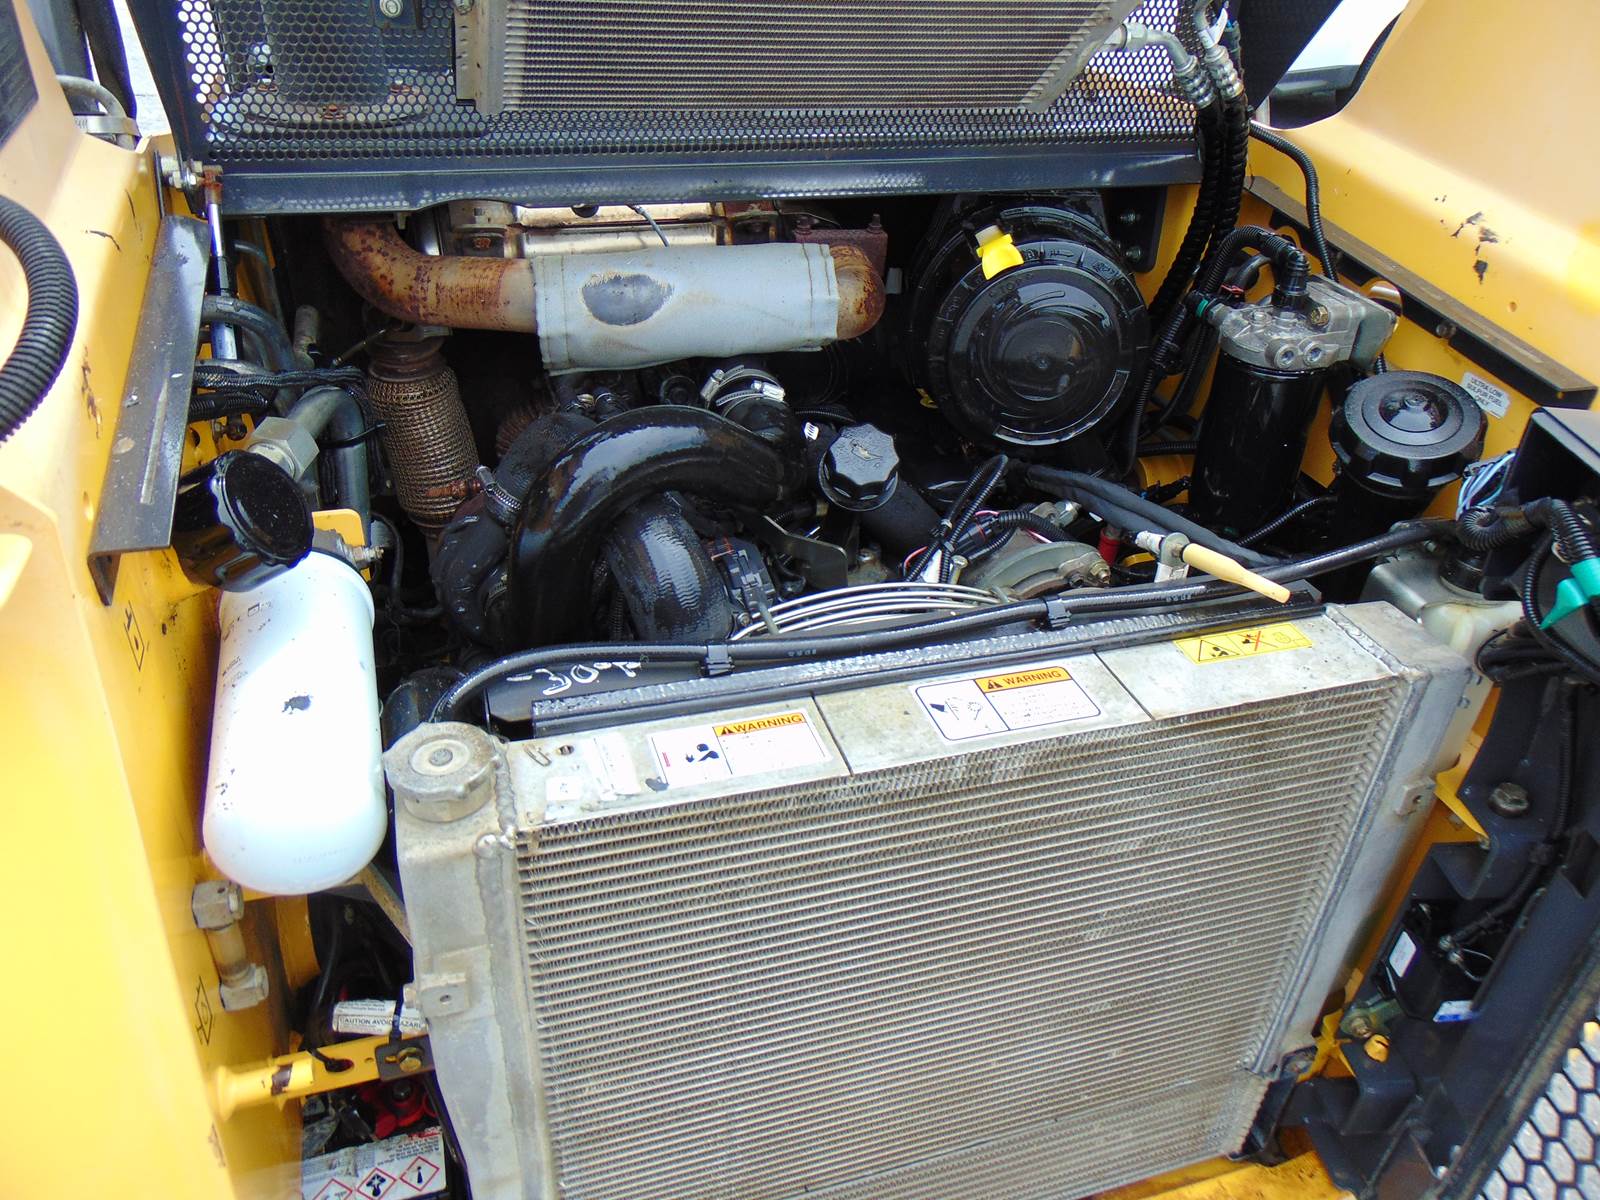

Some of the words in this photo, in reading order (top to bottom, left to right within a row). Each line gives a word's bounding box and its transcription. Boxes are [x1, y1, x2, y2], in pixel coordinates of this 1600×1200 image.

[1489, 387, 1503, 398] LOW
[1003, 671, 1062, 686] WARNING
[733, 714, 802, 733] WARNING
